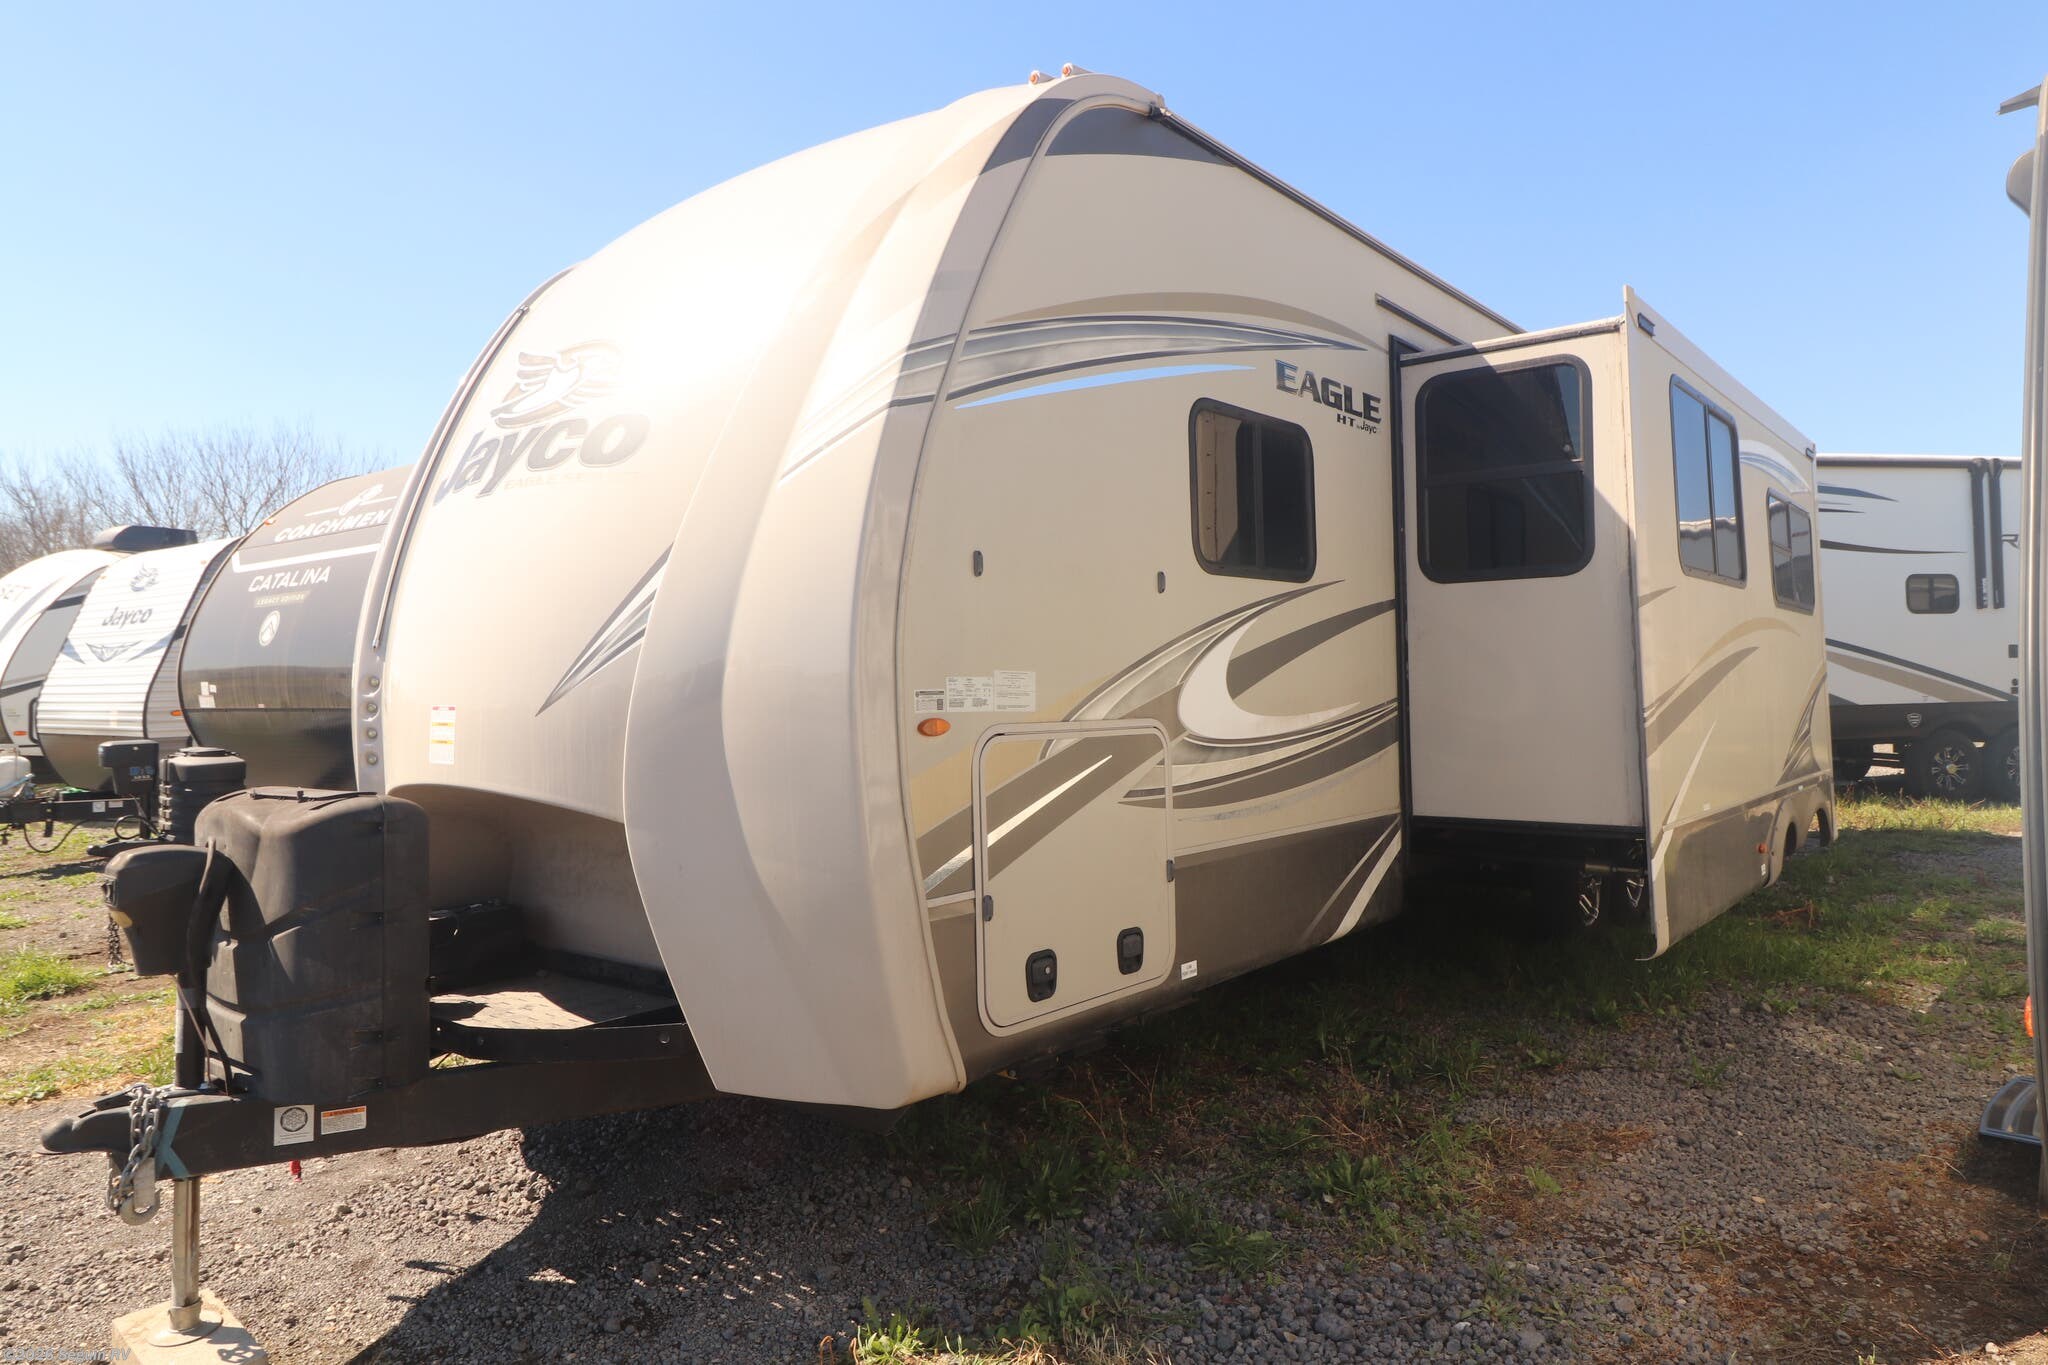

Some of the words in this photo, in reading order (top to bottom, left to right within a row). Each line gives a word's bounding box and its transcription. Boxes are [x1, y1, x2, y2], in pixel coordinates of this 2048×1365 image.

[1275, 359, 1382, 424] EAGLE
[1337, 414, 1356, 428] HT
[433, 412, 650, 507] Jayco
[274, 508, 392, 542] COACHMEN
[248, 566, 332, 592] CATALINA
[102, 607, 153, 629] Jayco
